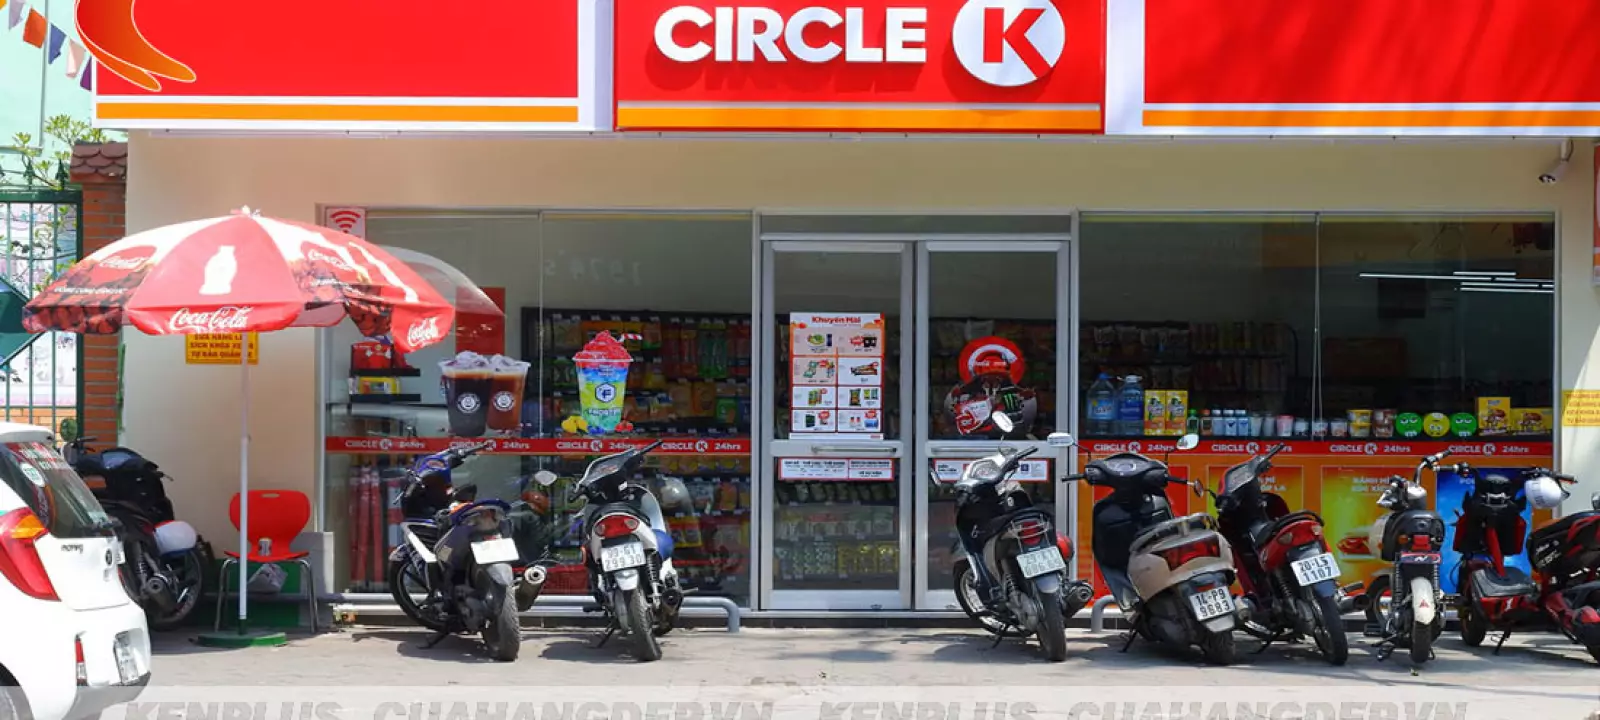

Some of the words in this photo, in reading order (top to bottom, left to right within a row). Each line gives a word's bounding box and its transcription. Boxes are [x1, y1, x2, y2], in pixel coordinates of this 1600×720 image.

[654, 5, 927, 63] CIRCLE
[979, 5, 1055, 81] K
[556, 441, 588, 449] CIRCLE
[662, 442, 693, 450] CIRCLE
[1094, 443, 1126, 452] CIRCLE
[1211, 444, 1244, 452] CIRCLE
[1330, 444, 1362, 453] CIRCLE
[1449, 445, 1480, 453] CIRCLE
[1303, 567, 1332, 582] 1107
